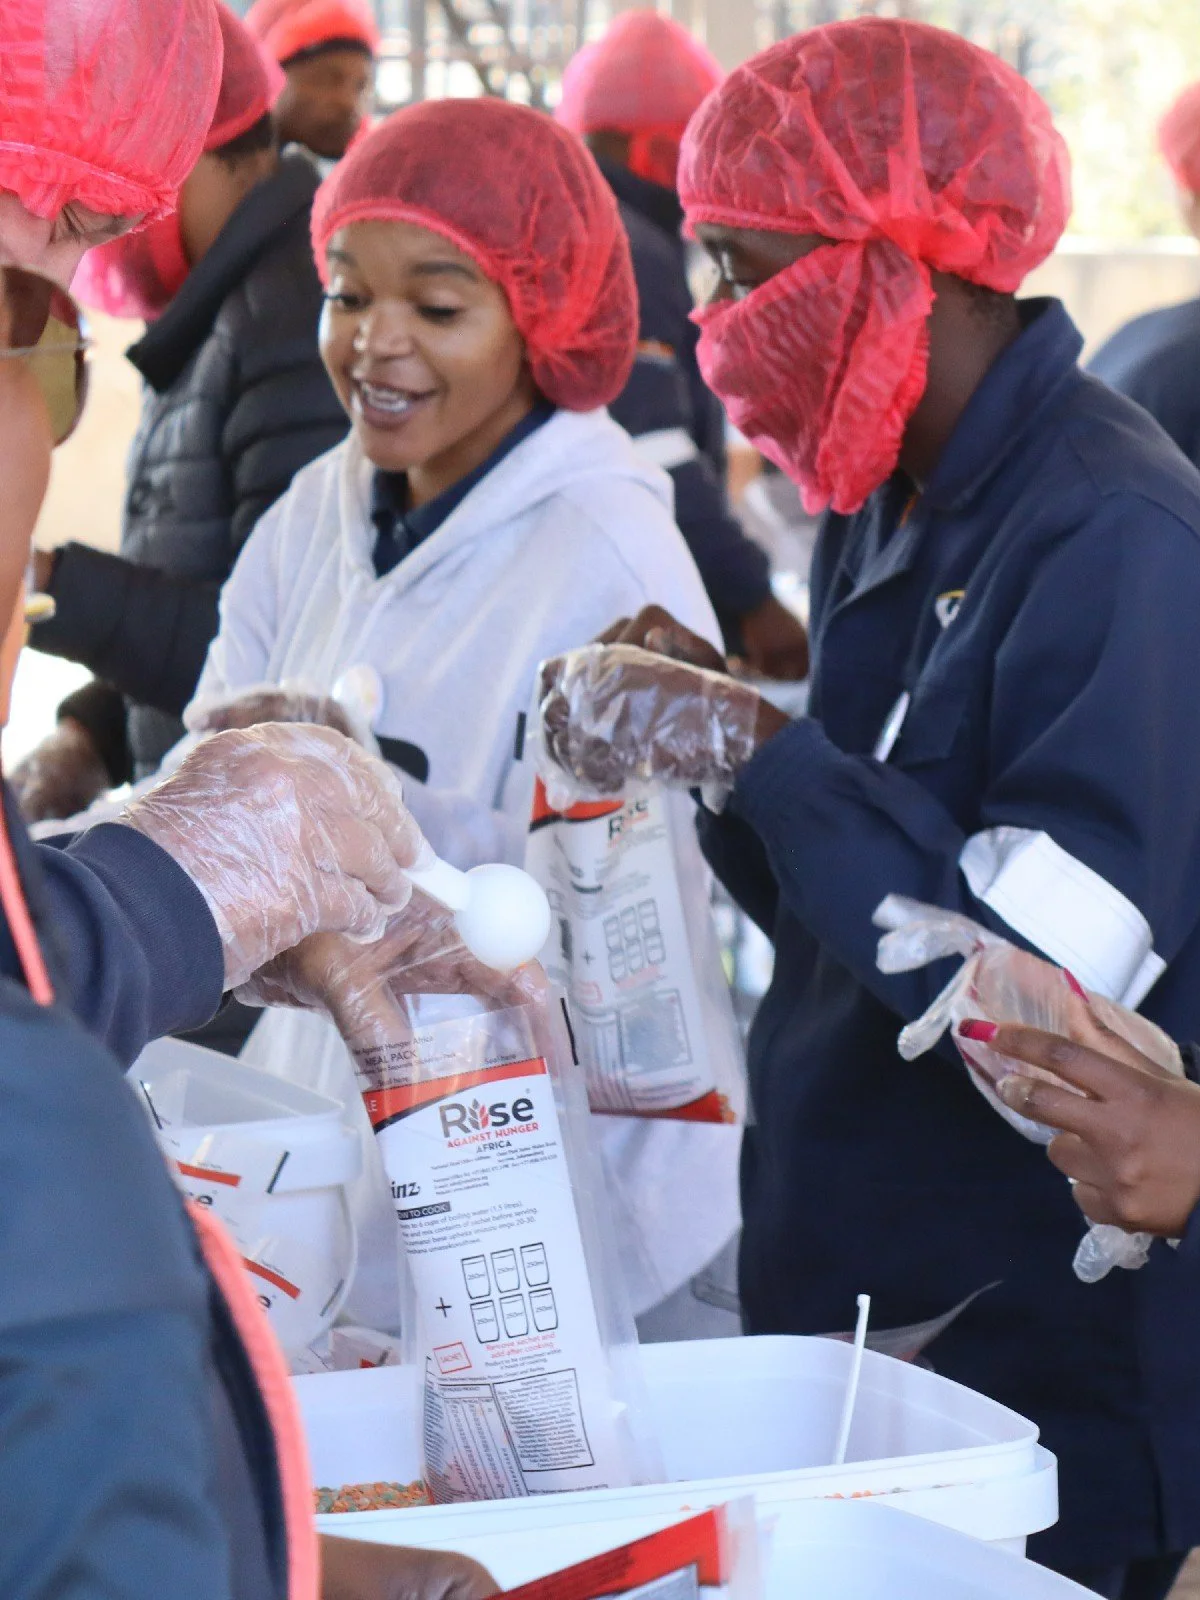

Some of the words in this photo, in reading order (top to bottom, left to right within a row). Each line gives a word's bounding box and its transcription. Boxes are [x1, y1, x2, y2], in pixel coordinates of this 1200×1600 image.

[385, 1041, 411, 1050] Hunger
[364, 1055, 388, 1066] MEAL
[390, 1050, 417, 1062] PACK
[439, 1097, 535, 1138] Rise
[446, 1131, 492, 1149] AGAINST
[495, 1122, 540, 1138] HUNGER
[476, 1139, 513, 1154] AFRICA
[492, 1213, 513, 1222] before
